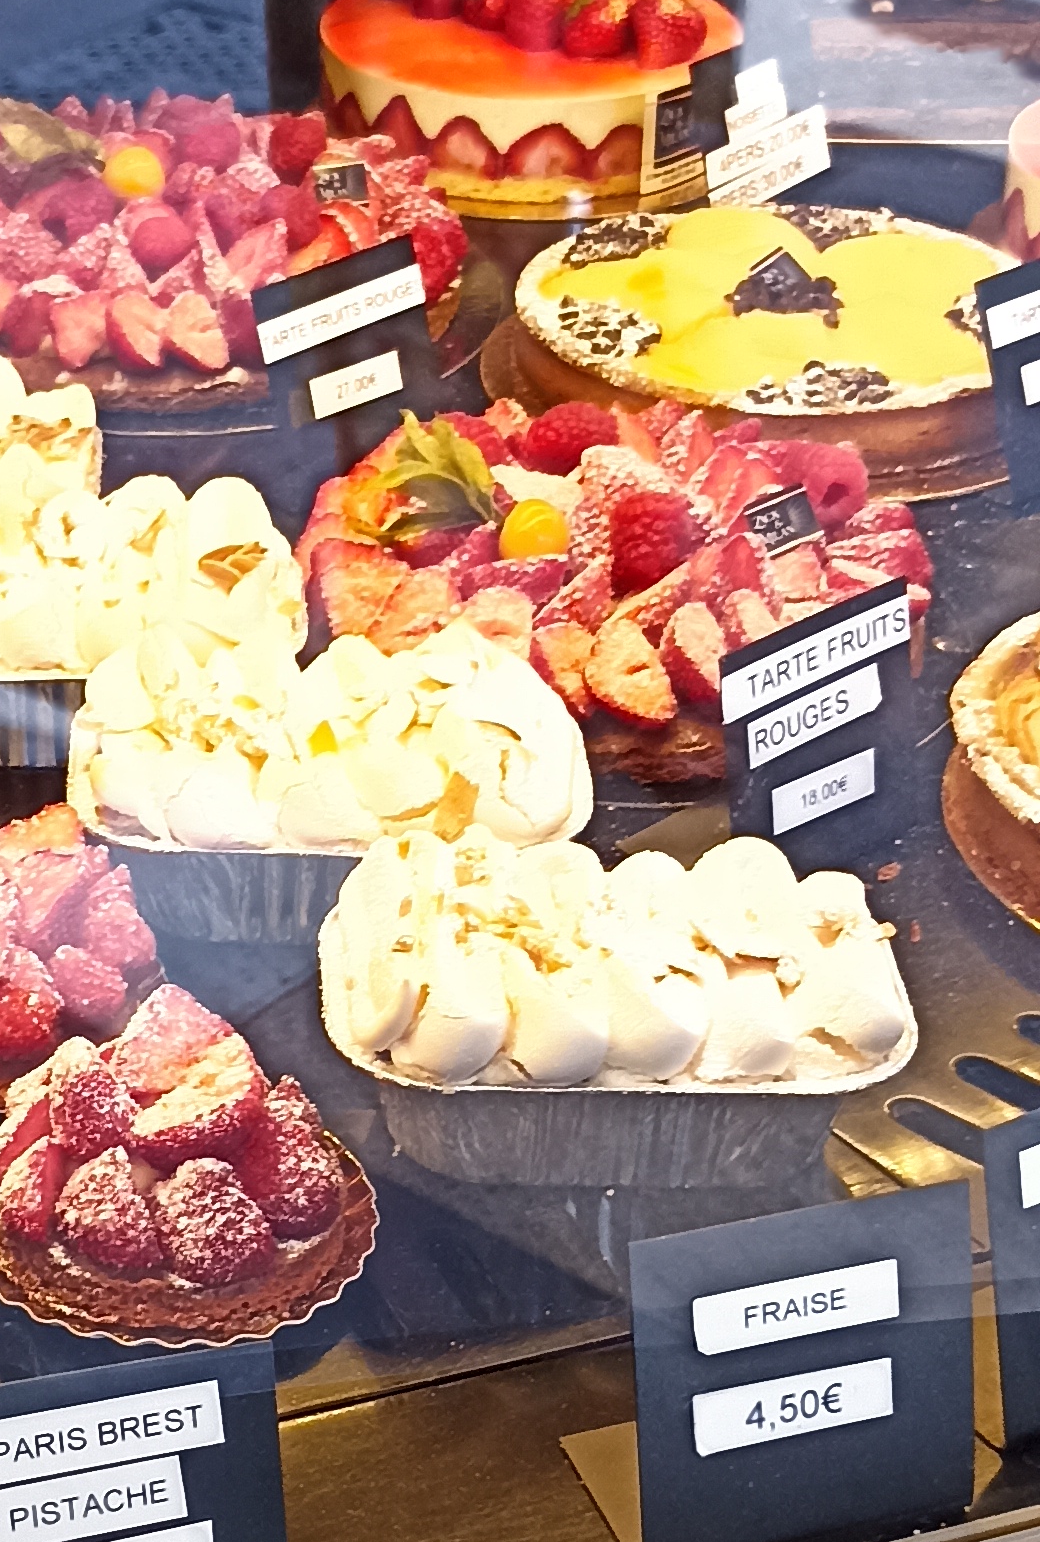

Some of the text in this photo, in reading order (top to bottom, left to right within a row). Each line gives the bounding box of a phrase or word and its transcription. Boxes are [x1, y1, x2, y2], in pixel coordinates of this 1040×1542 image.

[262, 322, 307, 350] TARTE
[310, 302, 362, 332] FRUITS
[747, 608, 906, 697] TARTE FRUITS
[754, 690, 849, 753] ROUGES
[801, 774, 848, 809] 18.00€
[744, 1288, 848, 1329] FRAISE
[98, 1404, 204, 1447] BREST
[745, 1382, 843, 1432] 4,50€
[9, 1479, 169, 1532] PISTACHE
